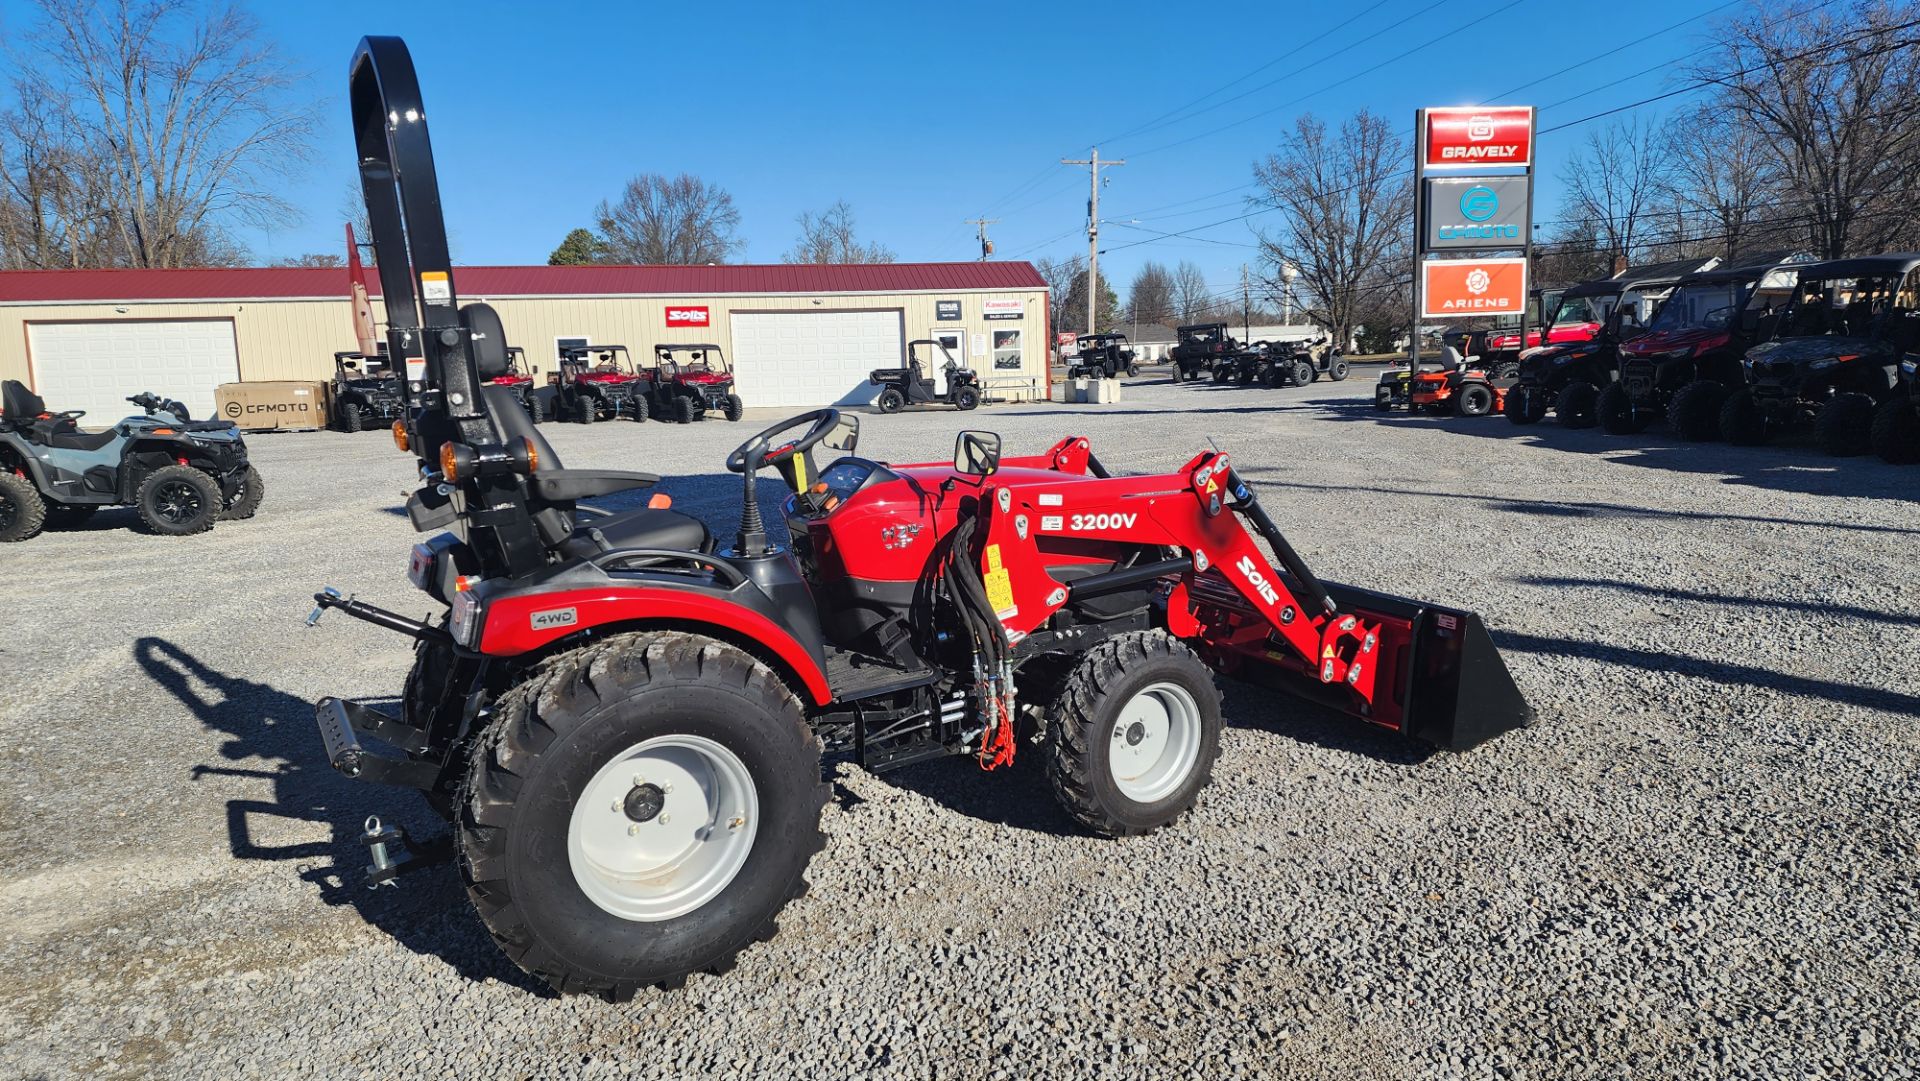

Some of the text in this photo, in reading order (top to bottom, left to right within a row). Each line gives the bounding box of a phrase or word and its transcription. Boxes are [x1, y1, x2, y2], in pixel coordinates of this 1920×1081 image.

[1441, 145, 1518, 159] GRAVELY
[1439, 224, 1519, 239] CFMOTO
[1442, 298, 1509, 309] ARIENS
[668, 310, 707, 320] Solis
[246, 404, 308, 413] CFMOTO
[1070, 512, 1137, 531] 3200V
[1236, 555, 1280, 606] Solis
[537, 612, 572, 624] 4WD
